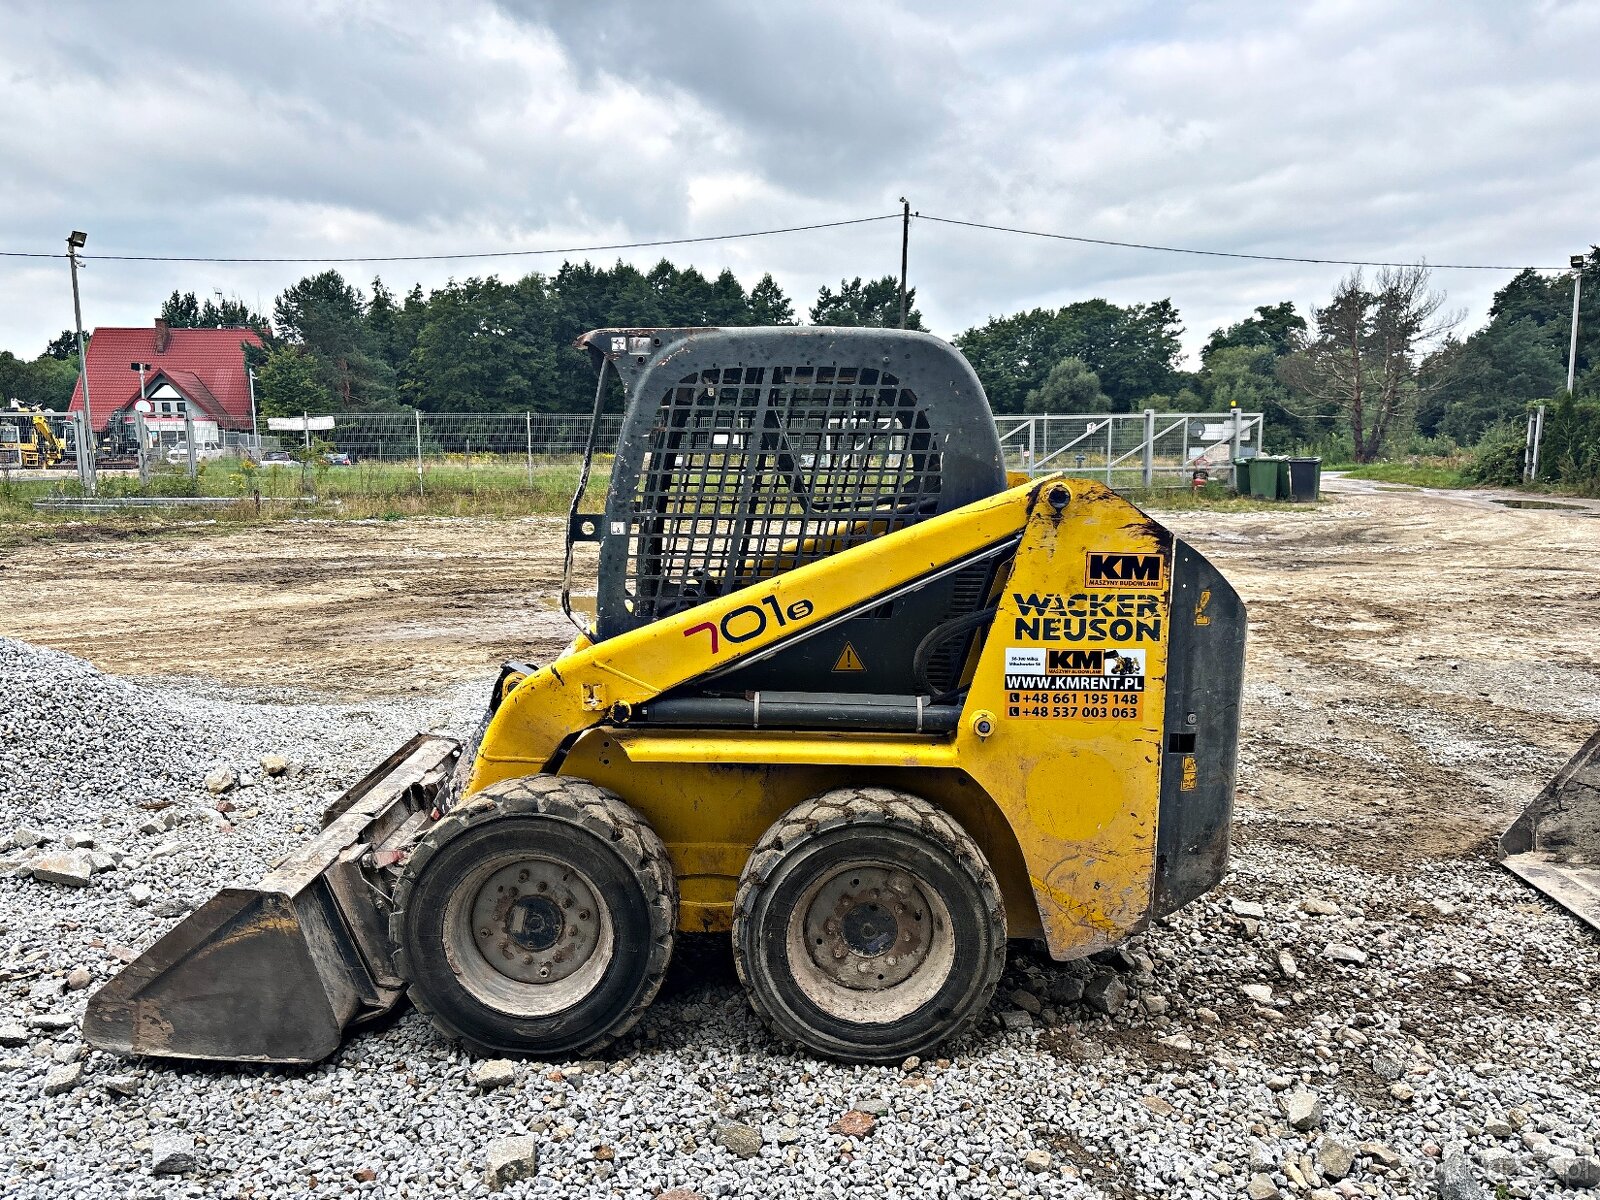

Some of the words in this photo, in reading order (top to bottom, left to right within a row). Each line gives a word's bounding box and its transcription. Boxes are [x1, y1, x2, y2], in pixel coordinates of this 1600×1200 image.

[1090, 555, 1160, 580] KM
[1013, 594, 1161, 617] WACKER
[1015, 618, 1161, 641] NEUSON
[1049, 651, 1102, 669] KM
[1006, 675, 1143, 690] WWW.KMRENT.PL
[1022, 693, 1049, 704] +48
[1052, 693, 1077, 704] 661
[1083, 693, 1108, 704] 195
[1113, 694, 1138, 705] 148
[1022, 707, 1049, 717] +48
[1052, 707, 1078, 718] 537
[1082, 707, 1107, 718] 003
[1112, 707, 1137, 718] 063
